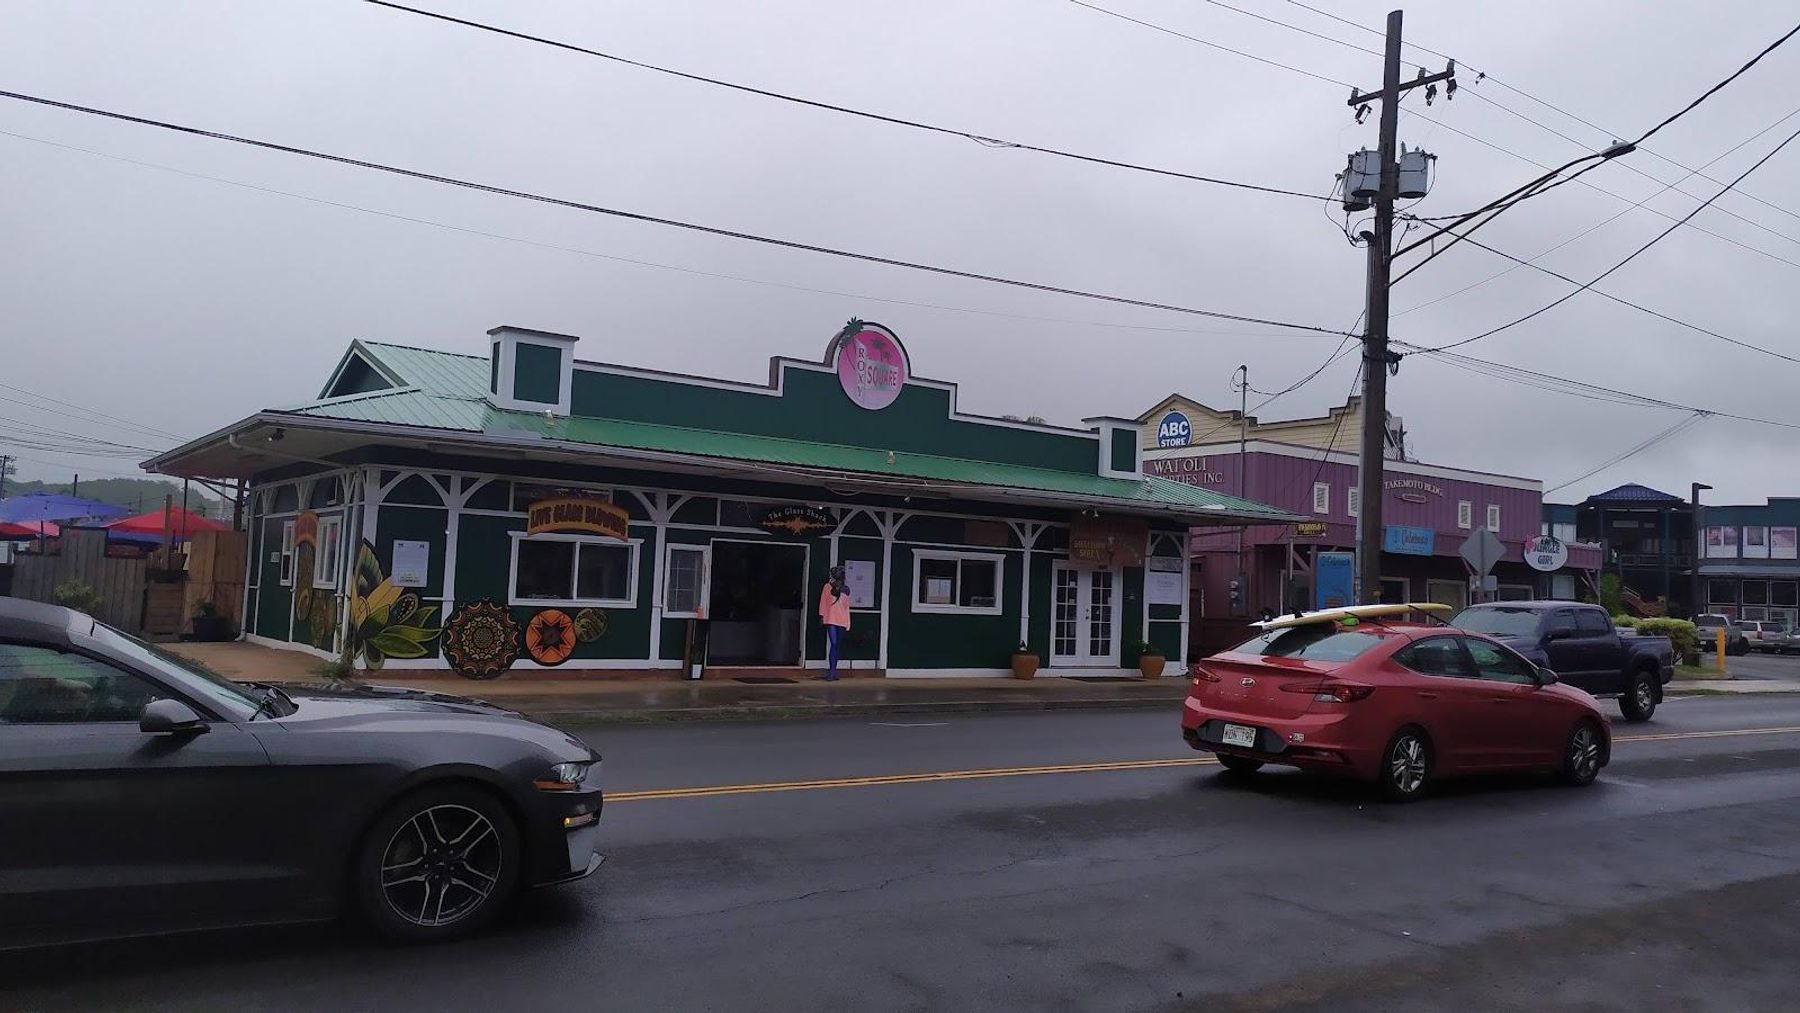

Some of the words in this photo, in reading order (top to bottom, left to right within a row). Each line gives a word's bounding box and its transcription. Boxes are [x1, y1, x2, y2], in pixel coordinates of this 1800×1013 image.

[857, 347, 865, 398] ROXY
[866, 365, 898, 387] SQUARE
[1160, 421, 1188, 437] ABC
[1161, 438, 1186, 447] STORE
[1384, 479, 1424, 490] TAKEMOTO
[1537, 554, 1554, 565] GIRL
